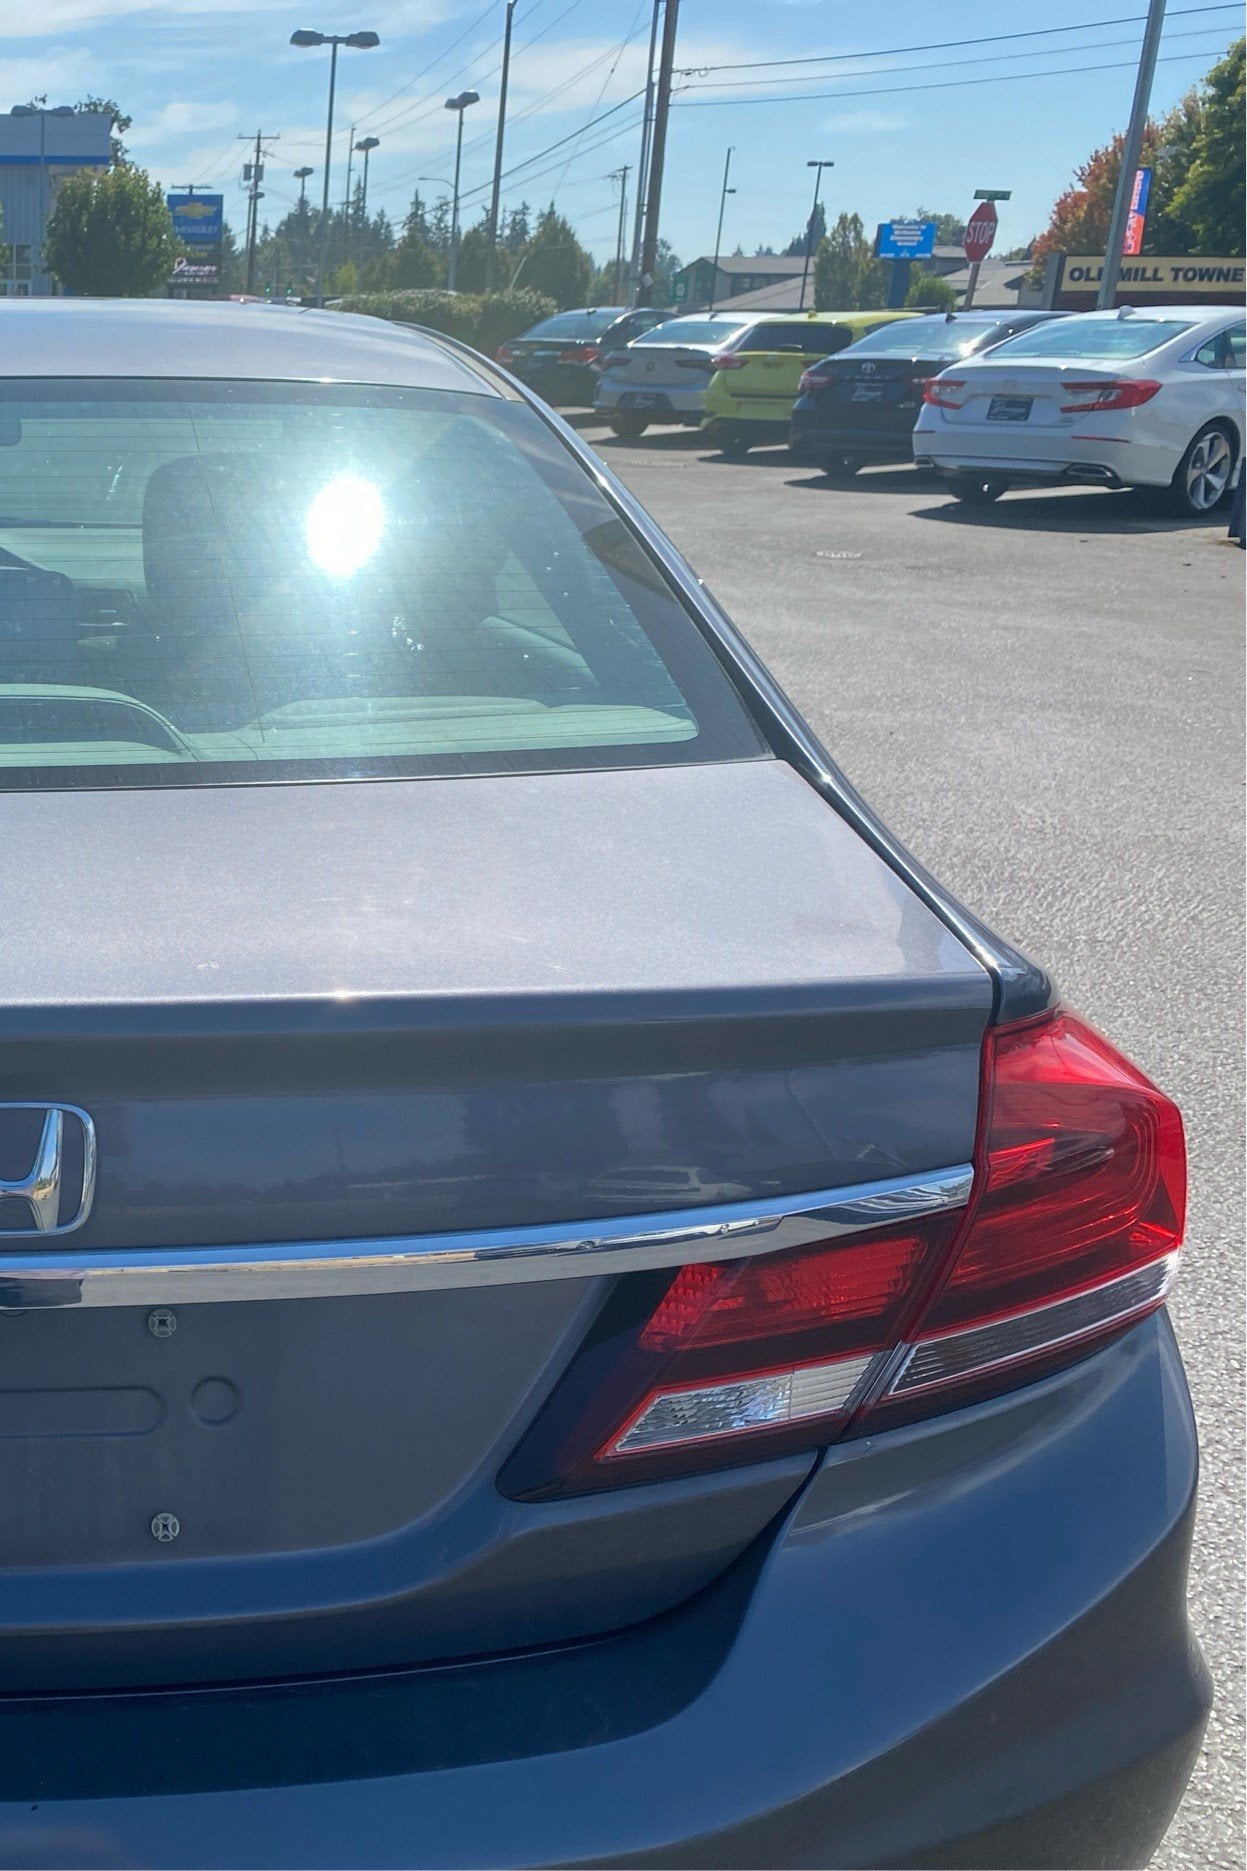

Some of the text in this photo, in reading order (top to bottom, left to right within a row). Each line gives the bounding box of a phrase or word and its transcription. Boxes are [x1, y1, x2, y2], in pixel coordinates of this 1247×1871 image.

[966, 221, 996, 244] STOP
[1118, 266, 1164, 283] MILL
[1170, 266, 1246, 283] TOWNE
